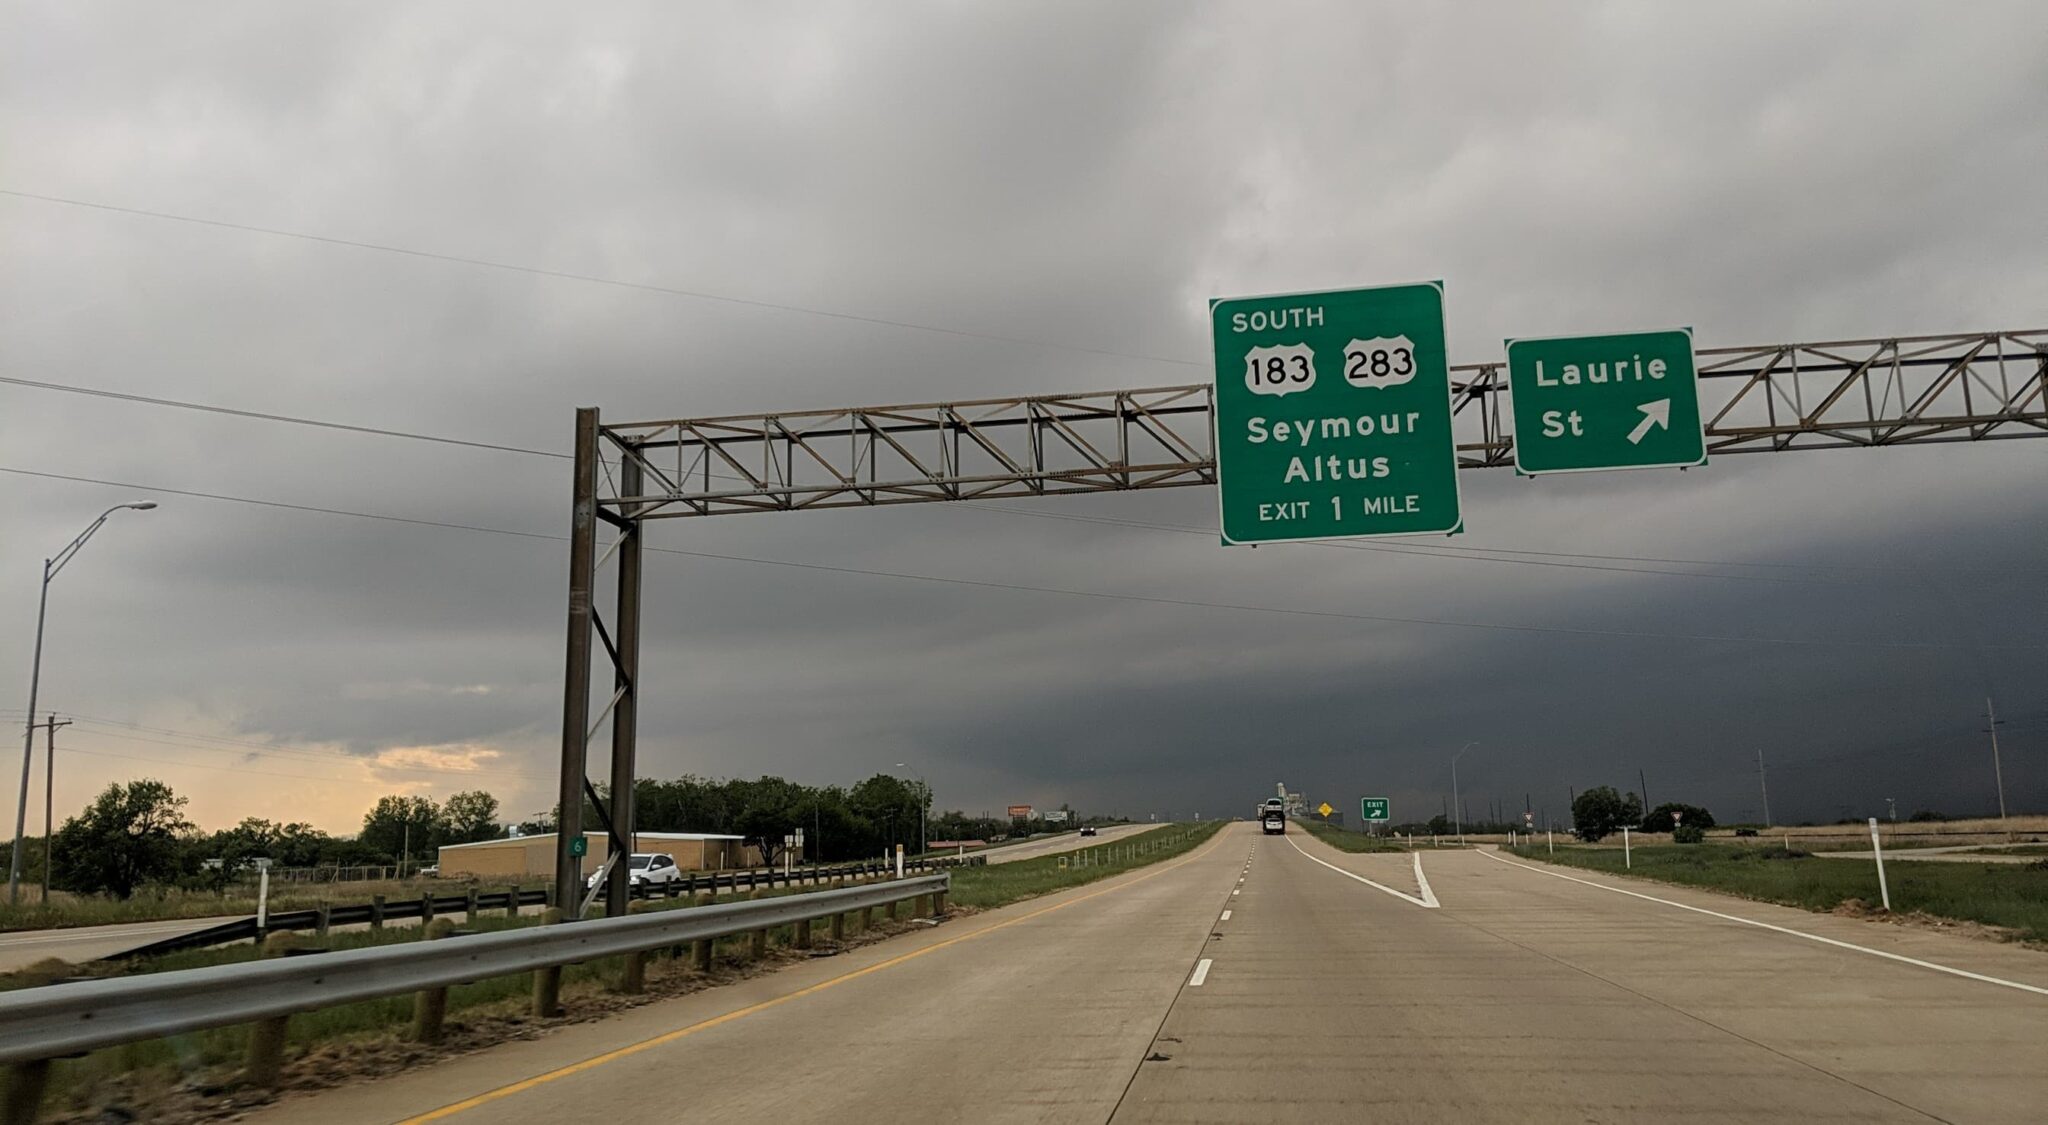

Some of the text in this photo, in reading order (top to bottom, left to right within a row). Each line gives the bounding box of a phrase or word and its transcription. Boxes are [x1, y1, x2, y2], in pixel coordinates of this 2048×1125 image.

[1232, 306, 1324, 332] SOUTH
[1251, 348, 1413, 385] 183 283
[1535, 354, 1667, 387] Laurie
[1247, 412, 1420, 446] Seymour
[1542, 410, 1584, 438] St
[1283, 454, 1390, 484] Altus
[1259, 495, 1420, 521] EXIT 1 MILE
[574, 841, 582, 852] 6
